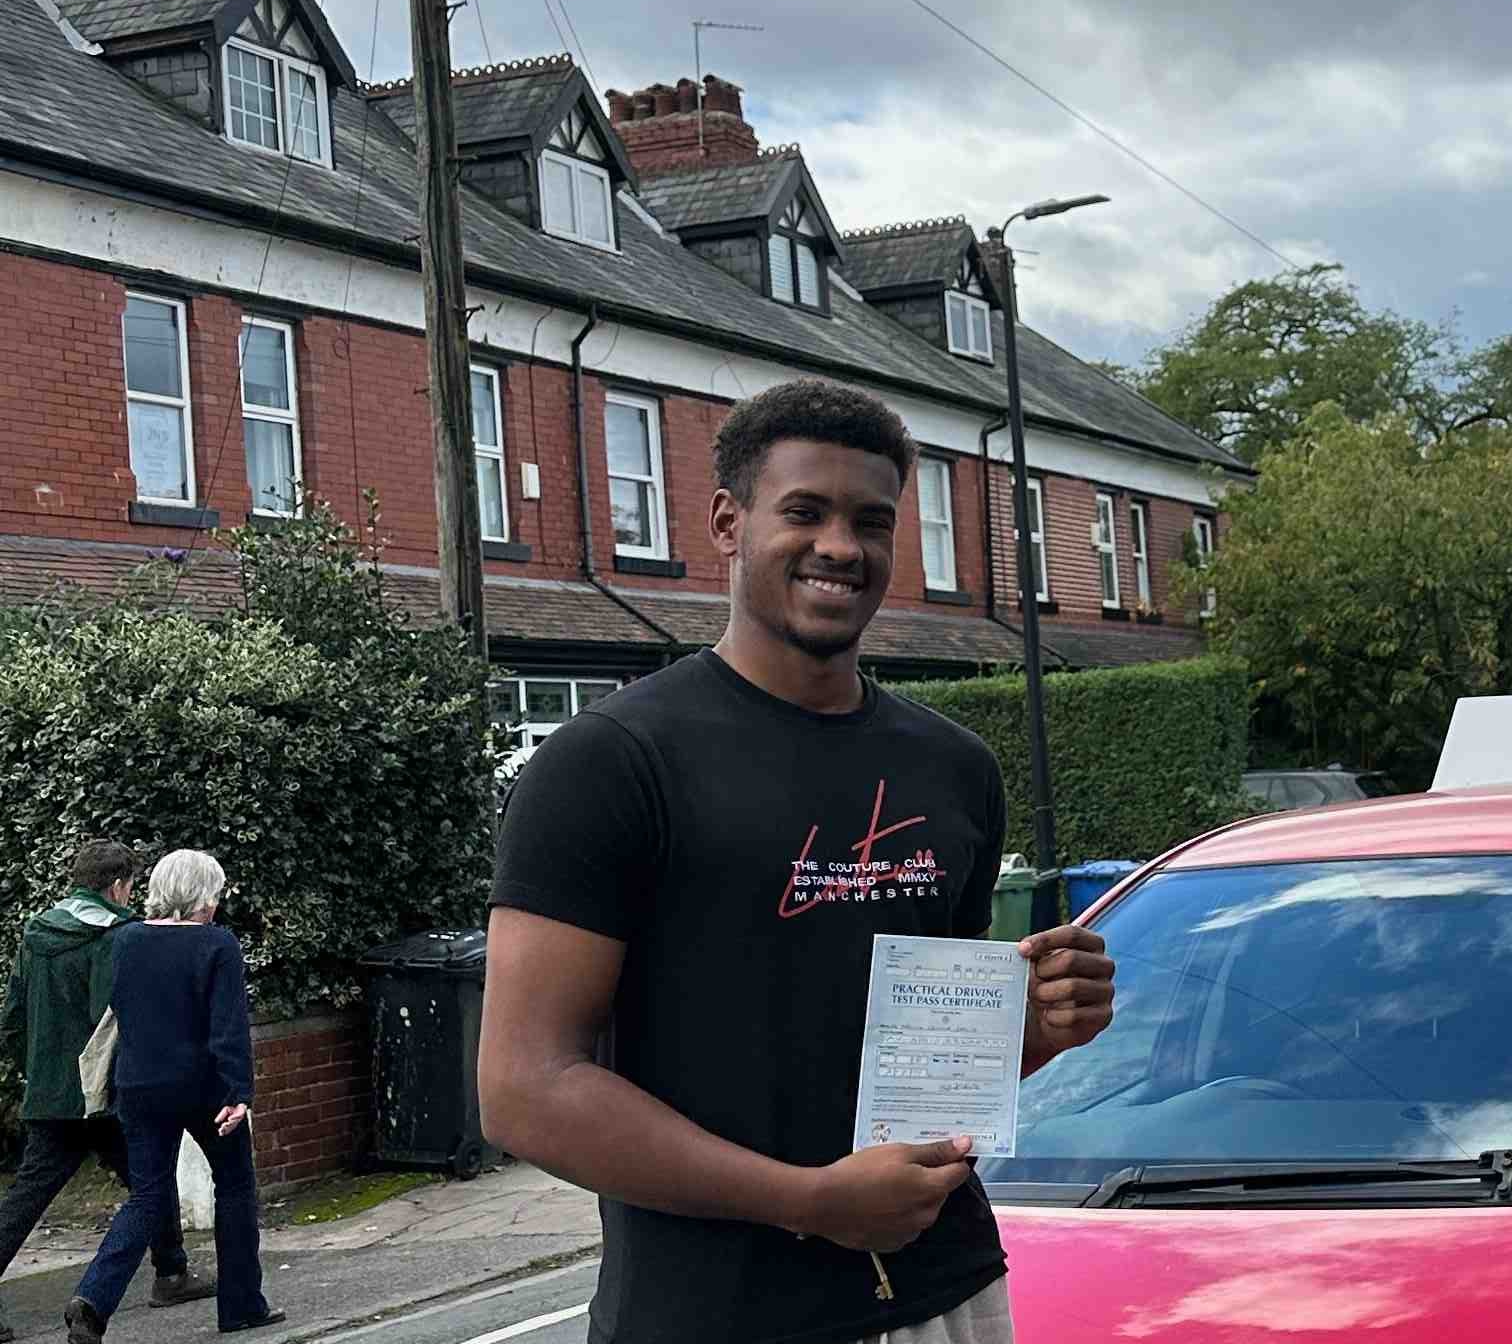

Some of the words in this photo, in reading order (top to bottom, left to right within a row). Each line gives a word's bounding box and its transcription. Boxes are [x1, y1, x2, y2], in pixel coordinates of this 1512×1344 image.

[792, 860, 819, 871] THE
[829, 860, 891, 873] COUTURE
[904, 858, 936, 869] CLUB
[794, 875, 877, 888] ESTABLISHED
[898, 872, 937, 883] MMXV
[794, 886, 939, 902] MANCHESTER
[892, 983, 952, 996] PRACTICAL
[954, 986, 1003, 998] DRIVING
[892, 994, 914, 1004] TEST
[916, 995, 940, 1006] PASS
[942, 997, 1003, 1009] CERTIFICATE
